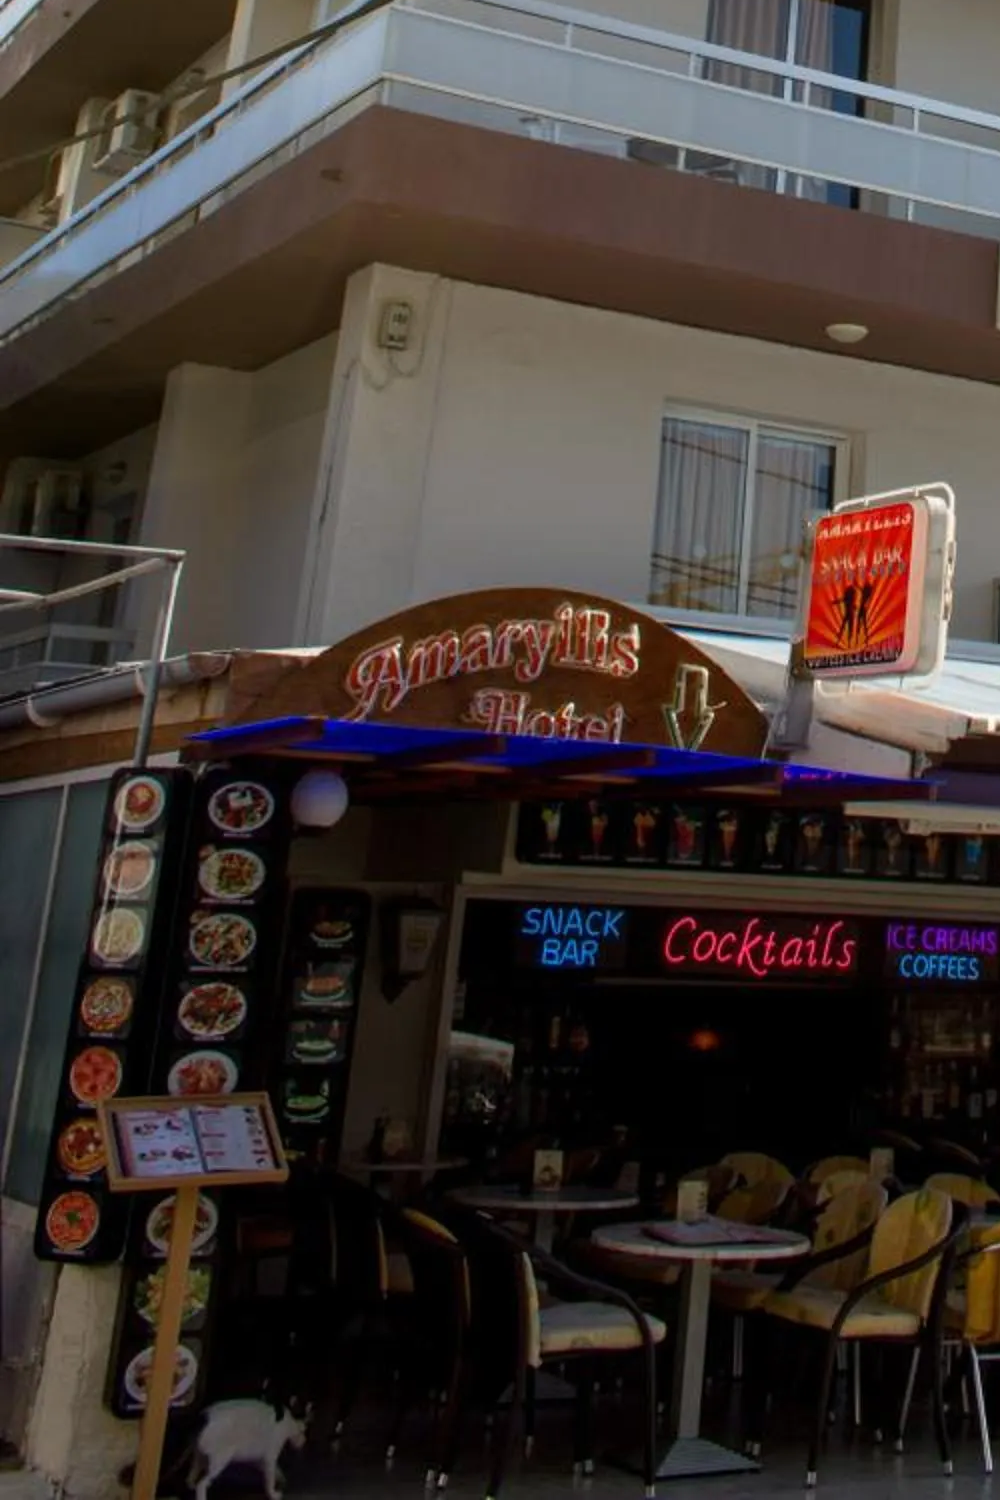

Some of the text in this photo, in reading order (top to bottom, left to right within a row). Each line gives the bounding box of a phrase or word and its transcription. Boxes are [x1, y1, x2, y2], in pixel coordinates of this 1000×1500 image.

[344, 601, 641, 722] Amaryllis
[460, 687, 626, 743] Hotel
[521, 906, 625, 940] SNACK
[886, 922, 998, 955] ICE CREAMS
[540, 938, 600, 967] BAR
[664, 916, 858, 977] Cocktails
[899, 954, 981, 981] COFFEES
